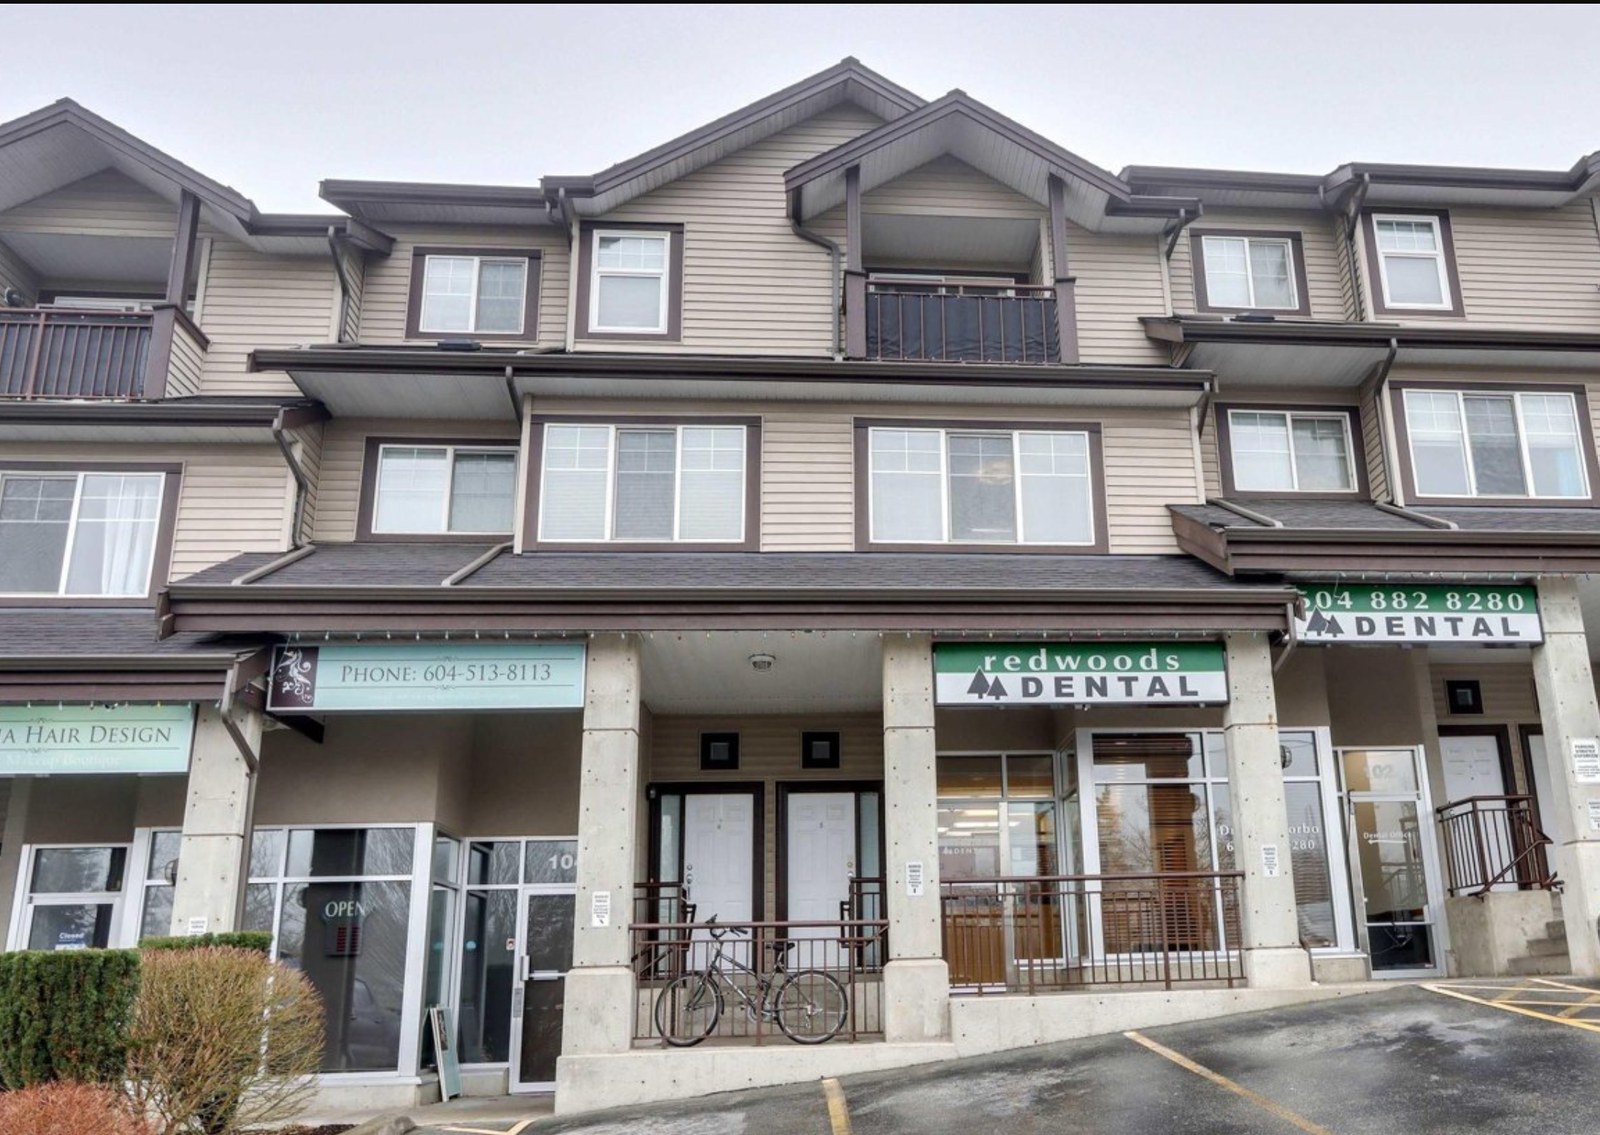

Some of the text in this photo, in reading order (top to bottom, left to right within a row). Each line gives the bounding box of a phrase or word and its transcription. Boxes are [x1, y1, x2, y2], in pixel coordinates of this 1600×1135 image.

[1370, 591, 1429, 609] 882
[1446, 592, 1524, 611] 8280
[1355, 616, 1521, 637] DENTAL
[984, 648, 1180, 671] redwoods
[341, 664, 551, 682] PHONE: 604-513-8113
[1021, 675, 1199, 698] DENTAL
[0, 725, 171, 744] A HAIR DESIGN
[1289, 823, 1319, 834] orbo
[1226, 839, 1315, 852] 6 280
[325, 900, 367, 917] OPEN
